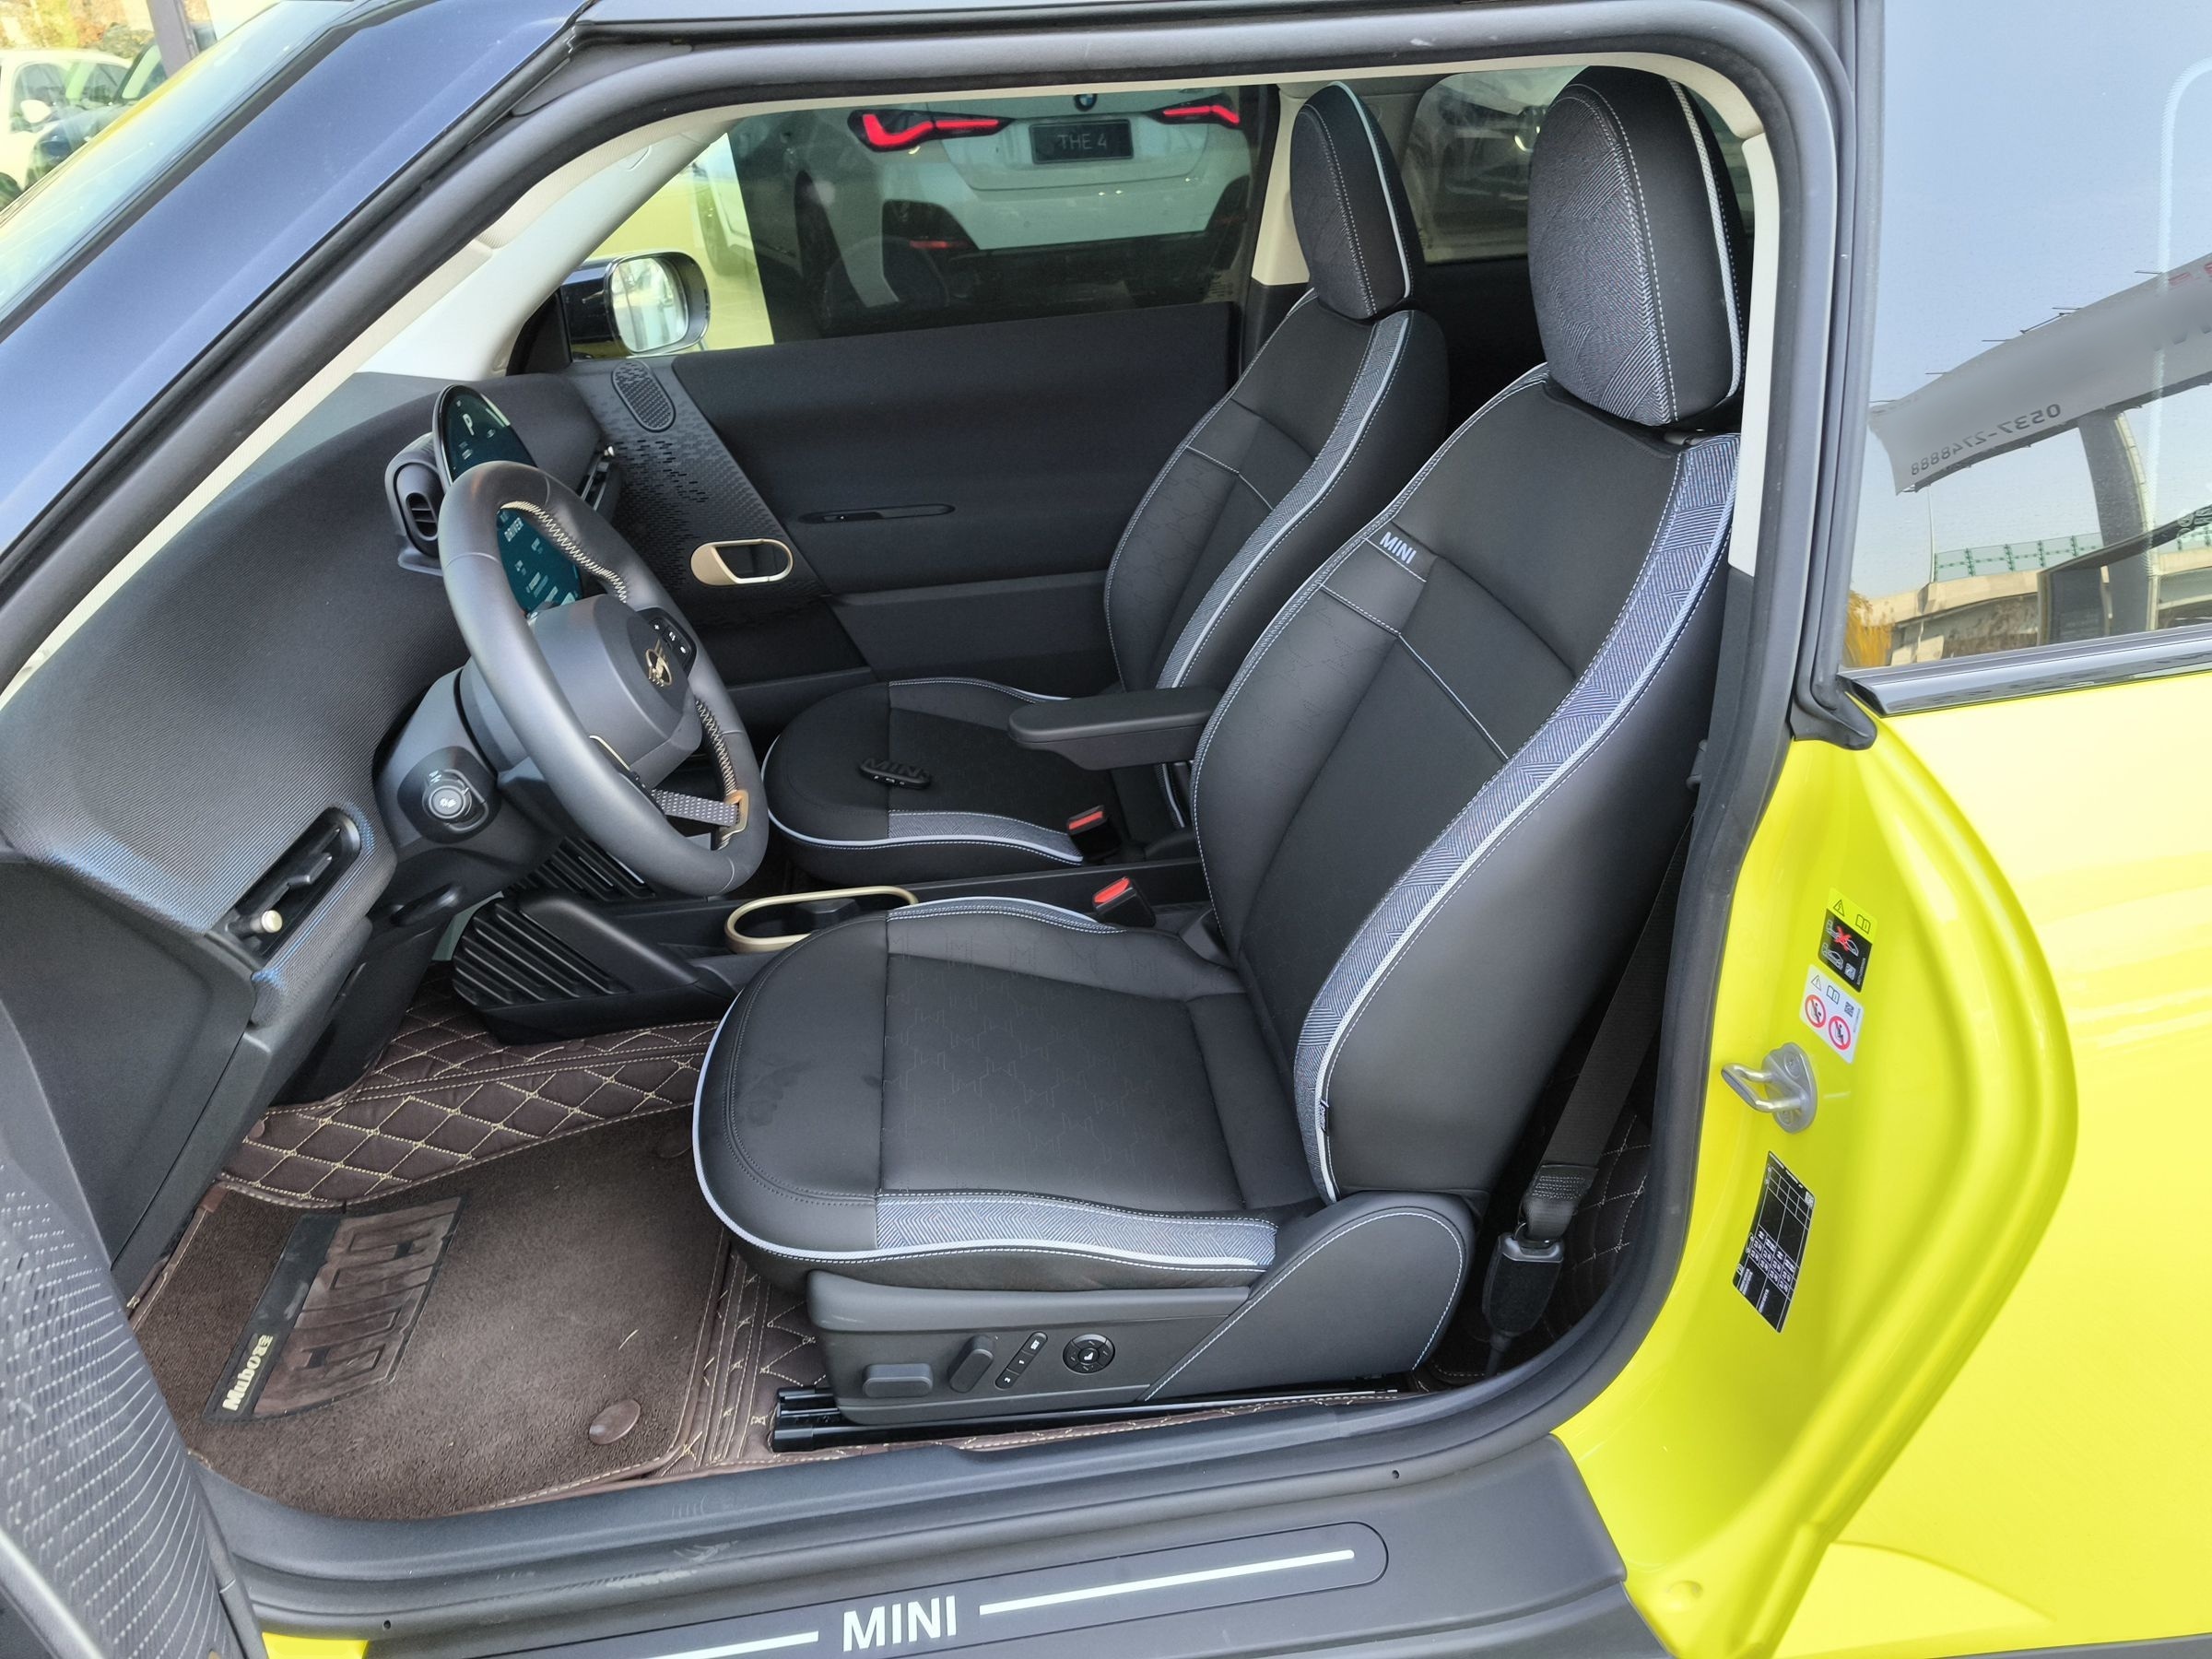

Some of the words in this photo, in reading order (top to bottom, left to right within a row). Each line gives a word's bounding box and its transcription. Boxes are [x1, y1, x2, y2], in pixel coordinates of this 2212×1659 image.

[1057, 133, 1092, 150] THE
[1097, 133, 1108, 149] 4
[462, 413, 475, 436] P
[1379, 531, 1418, 564] MINI
[842, 1594, 957, 1653] MINI
